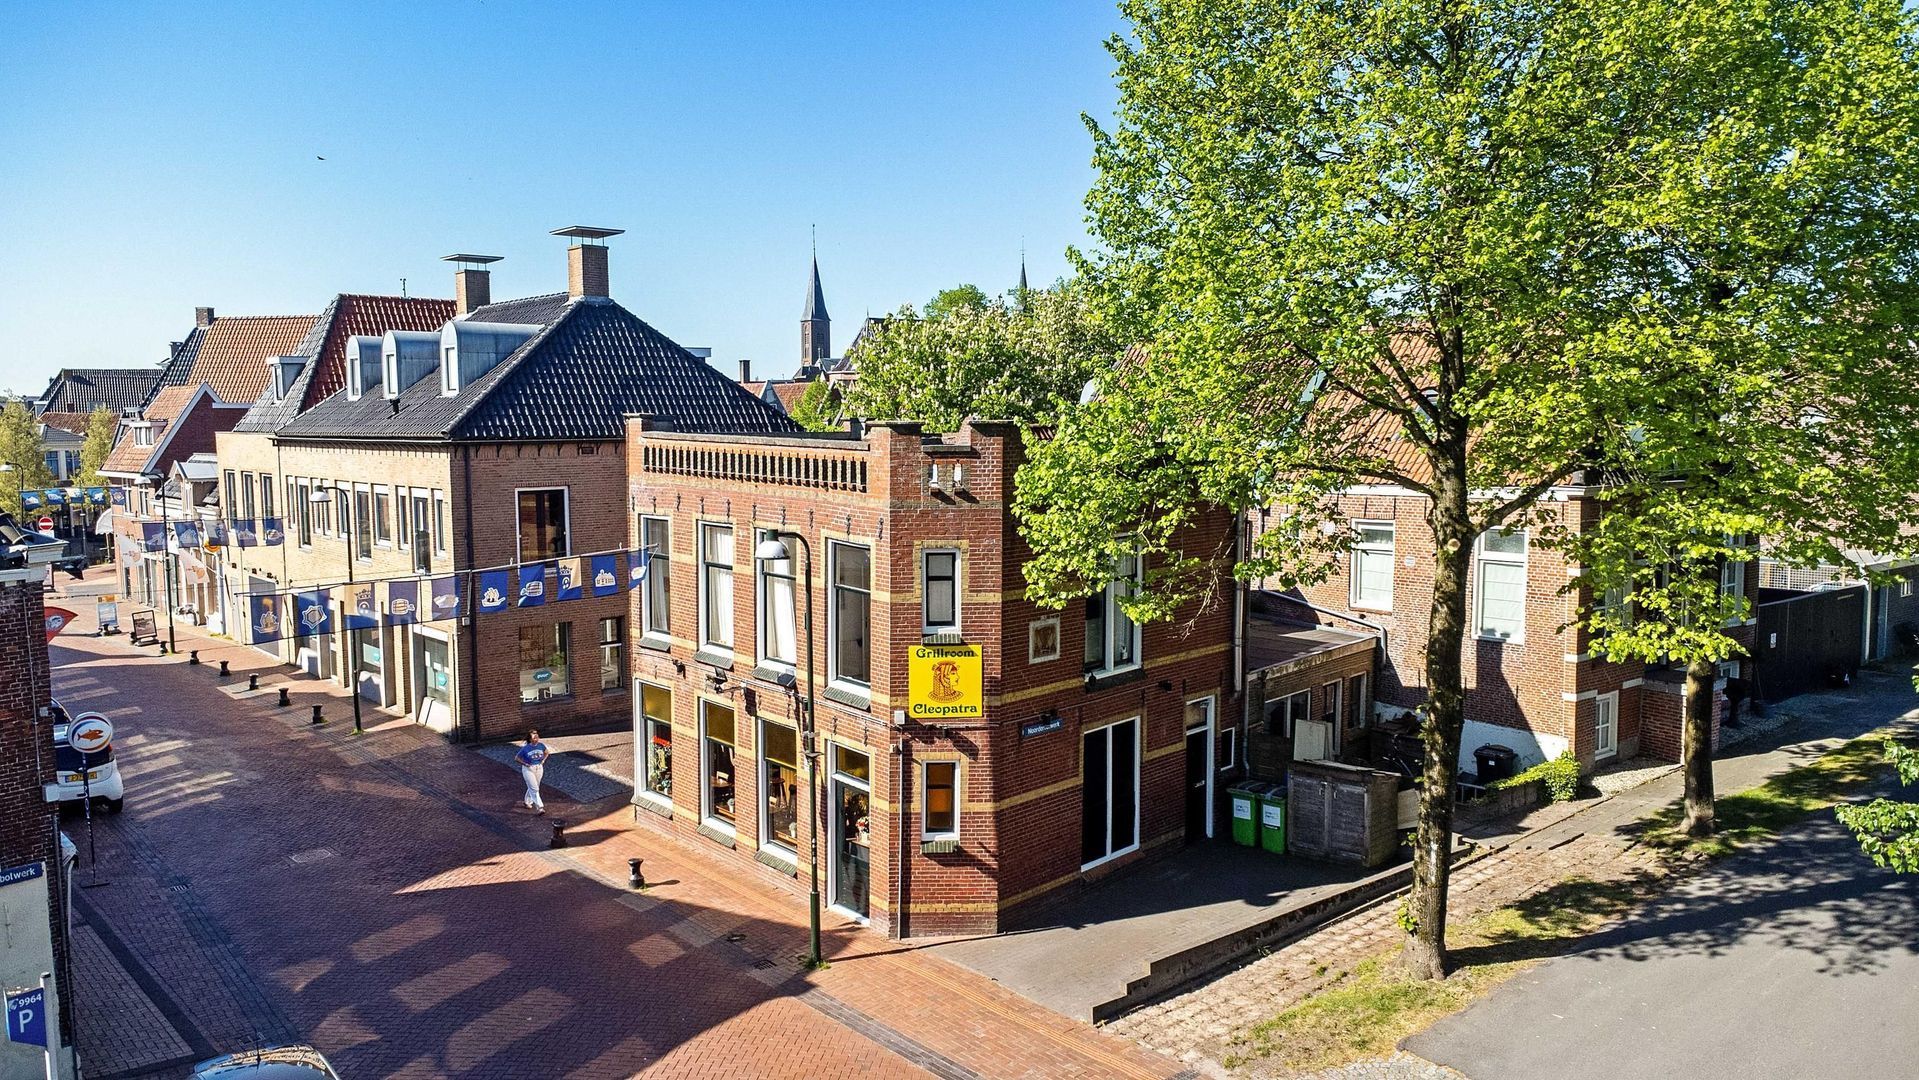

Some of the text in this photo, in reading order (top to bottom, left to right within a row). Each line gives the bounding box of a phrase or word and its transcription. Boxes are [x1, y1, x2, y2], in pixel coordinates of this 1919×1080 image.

[916, 648, 975, 658] Grillroom
[913, 704, 977, 715] Cleopatra
[1027, 721, 1060, 735] Noorderwerk
[18, 993, 42, 1008] 9964
[18, 1009, 34, 1033] P
